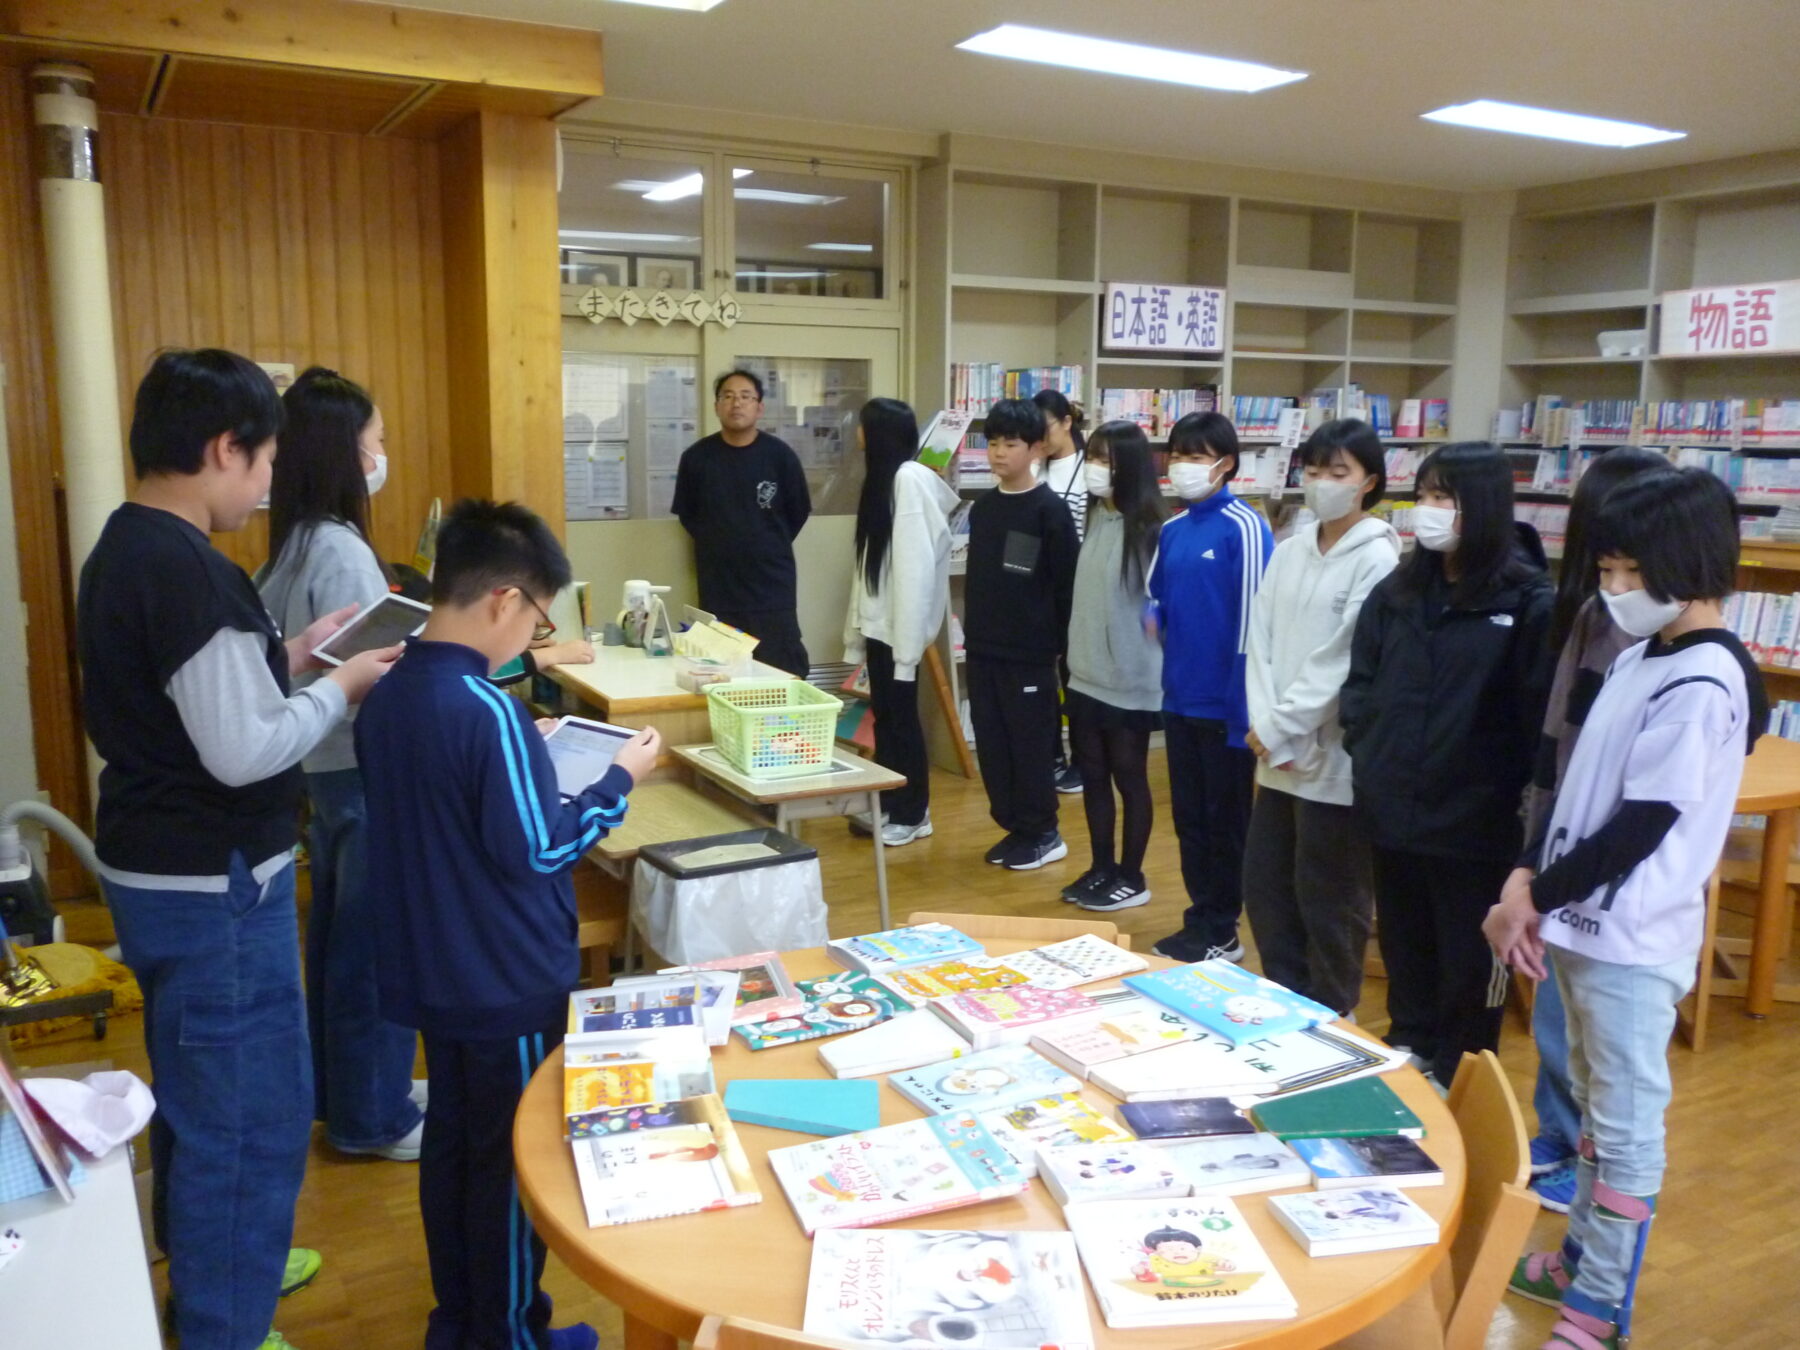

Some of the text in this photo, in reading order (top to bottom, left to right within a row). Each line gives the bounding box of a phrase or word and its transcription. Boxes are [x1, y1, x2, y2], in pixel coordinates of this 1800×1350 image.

[586, 290, 740, 321] またきてね
[1111, 287, 1219, 347] 日本語・英語
[1688, 288, 1777, 351] 物語
[839, 1257, 861, 1309] モリスくんと
[867, 1236, 885, 1333] オレンジいろのドレス
[1154, 1288, 1238, 1301] 鈴木のりたけ
